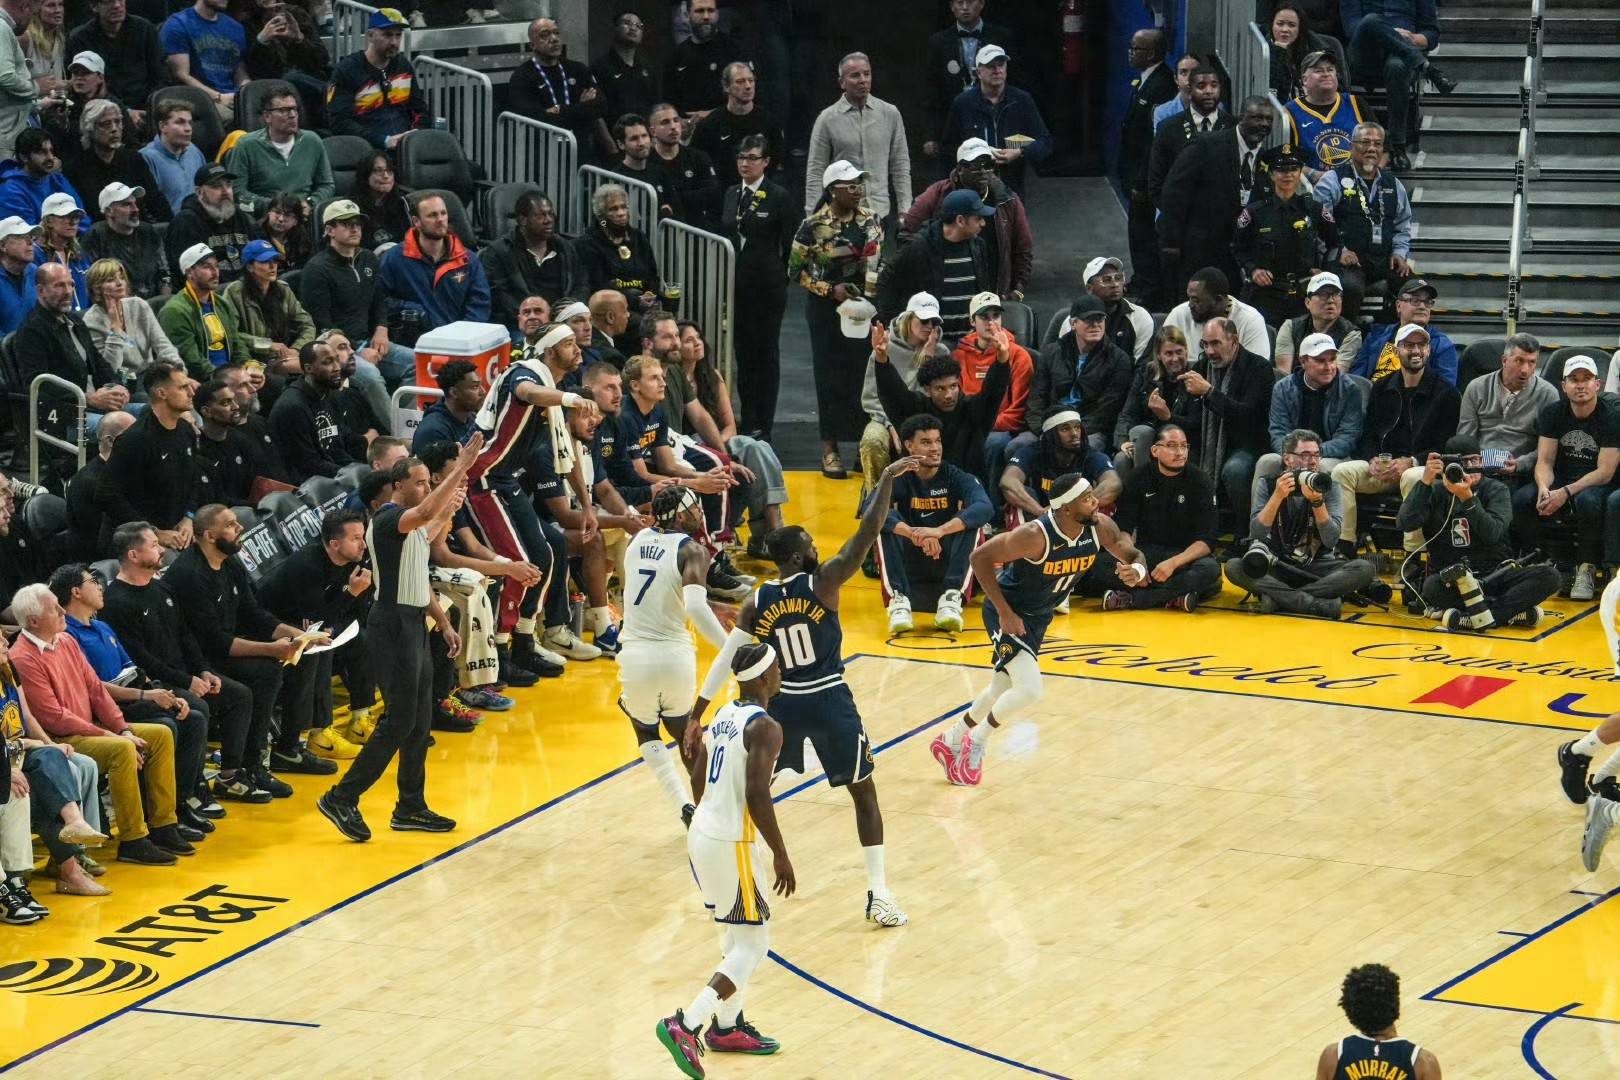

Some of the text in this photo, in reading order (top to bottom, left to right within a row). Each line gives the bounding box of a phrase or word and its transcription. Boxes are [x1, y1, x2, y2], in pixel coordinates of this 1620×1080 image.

[1330, 137, 1340, 147] 10
[47, 409, 58, 424] 4
[640, 545, 665, 560] HIELD
[1043, 553, 1096, 576] DENVER
[633, 568, 657, 606] 7
[1052, 574, 1075, 593] 11
[755, 598, 826, 637] HARDAWAY JR.
[775, 623, 817, 669] 10
[8, 709, 16, 721] 13
[708, 744, 725, 784] 10
[94, 883, 291, 959] AT&T
[1344, 1059, 1408, 1080] MURRAY
